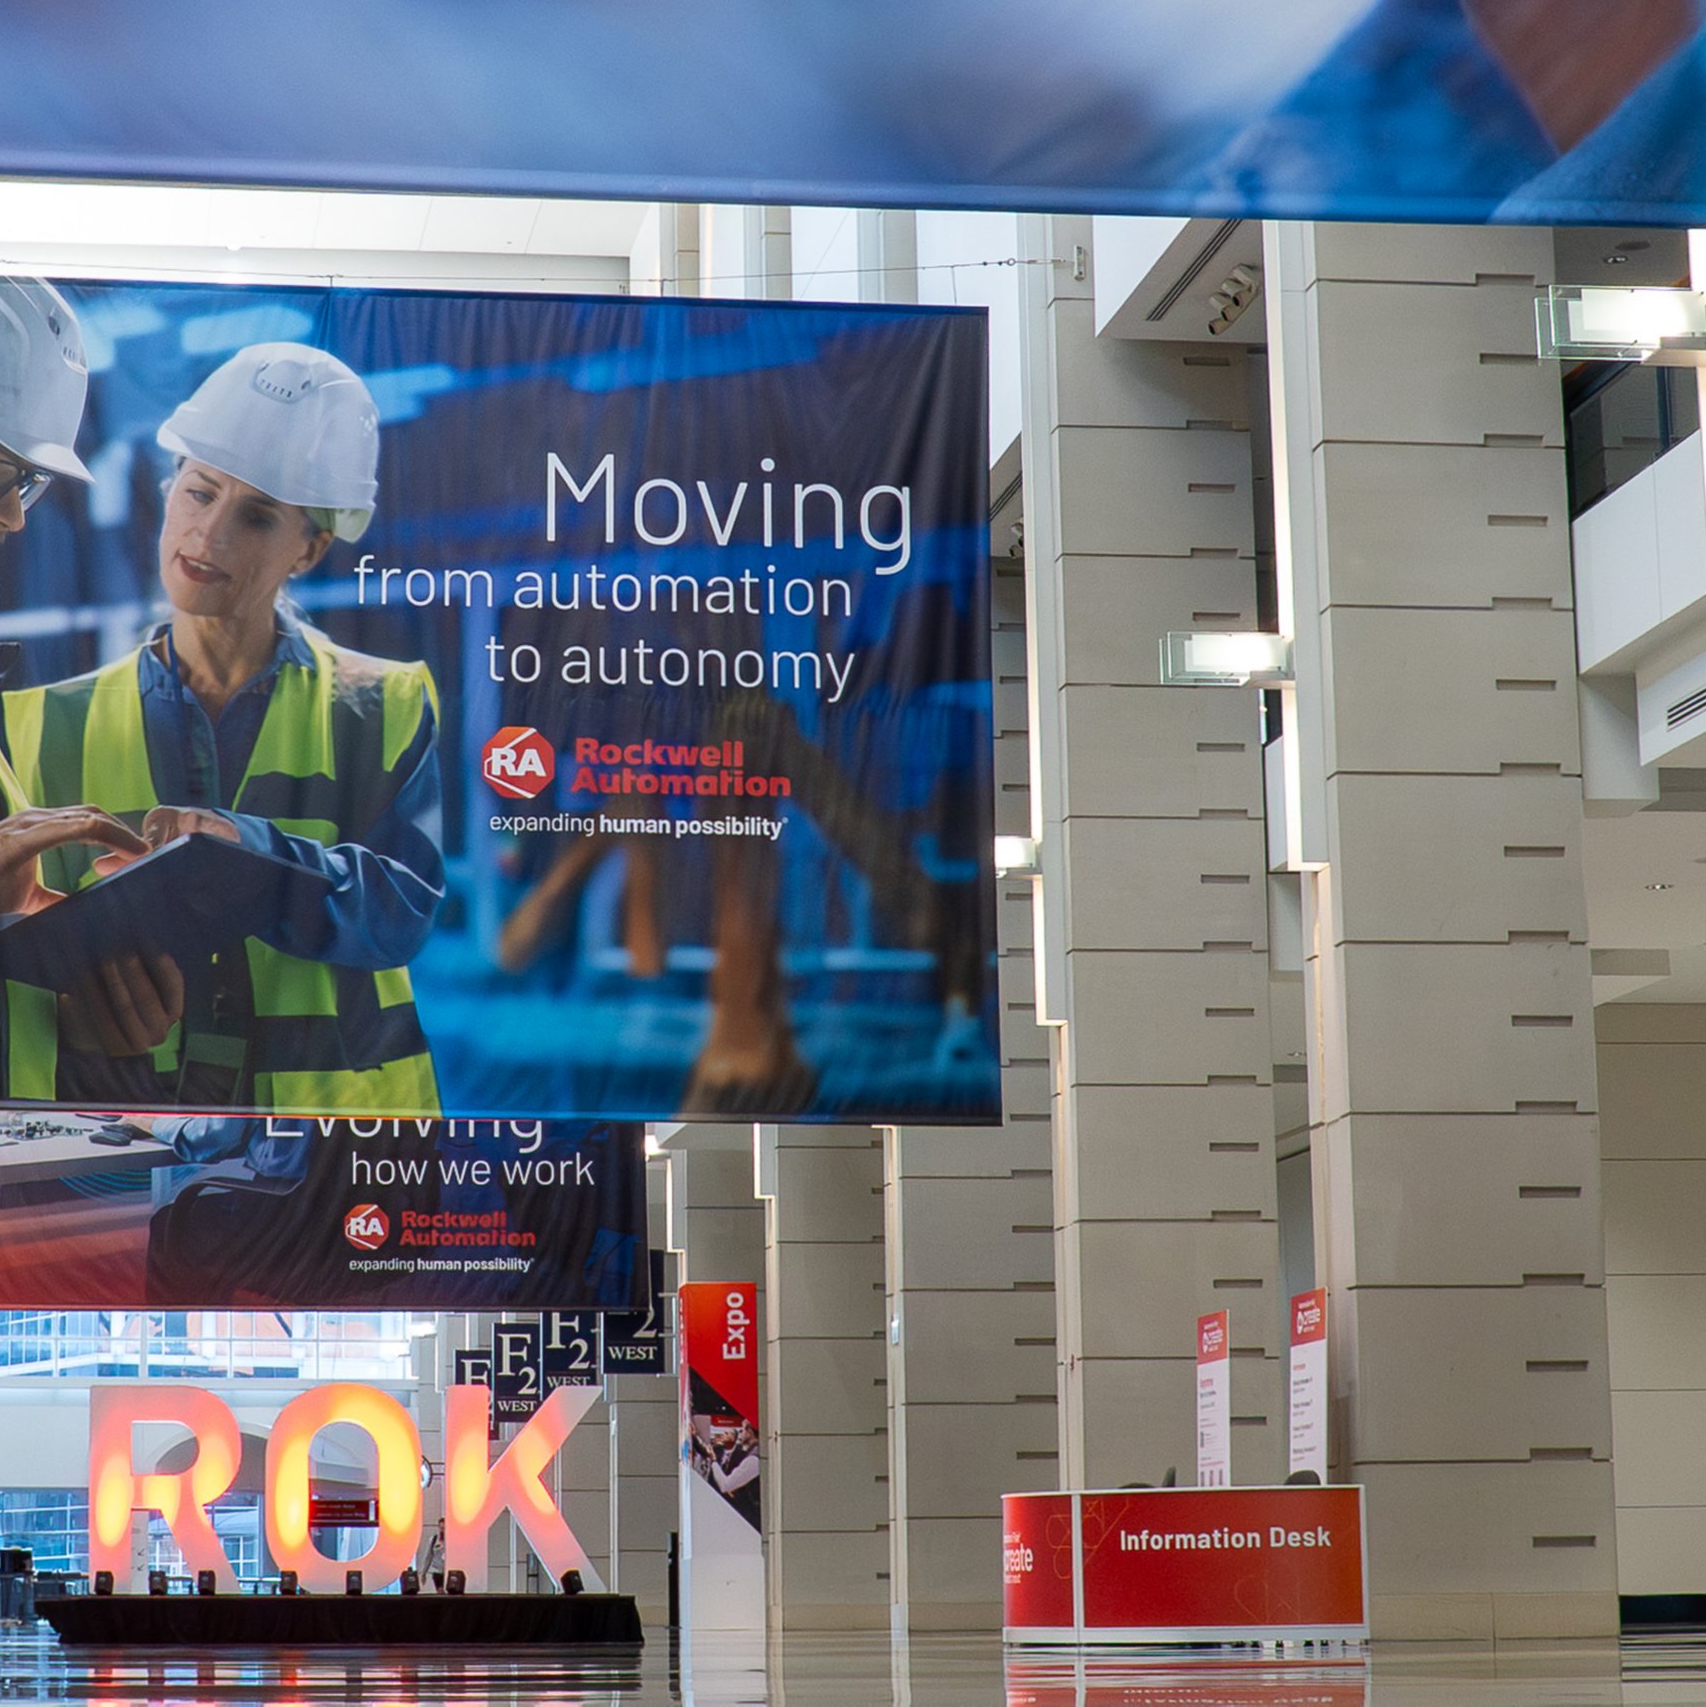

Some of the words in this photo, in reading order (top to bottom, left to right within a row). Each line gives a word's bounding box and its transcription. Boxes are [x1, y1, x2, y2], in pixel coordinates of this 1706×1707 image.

[545, 451, 912, 575] Moving
[354, 555, 493, 607] from
[513, 564, 853, 618] automation
[485, 635, 541, 682] to
[561, 638, 856, 703] autonomy
[491, 747, 547, 777] RA
[574, 737, 744, 768] Rockwell
[570, 767, 792, 797] Automation
[489, 813, 595, 837] expanding
[599, 814, 671, 835] human
[351, 1151, 428, 1186] how
[439, 1160, 491, 1186] we
[502, 1152, 595, 1186] work
[349, 1217, 385, 1236] RA
[400, 1211, 507, 1228] Rockwell
[399, 1229, 536, 1247] Automation
[349, 1258, 415, 1273] expanding
[417, 1258, 461, 1271] human
[722, 1291, 750, 1360] Expo
[607, 1346, 658, 1360] WEST
[497, 1401, 538, 1412] WEST
[89, 1382, 604, 1595] ROK
[1120, 1527, 1261, 1551] Information
[1269, 1526, 1332, 1547] Desk
